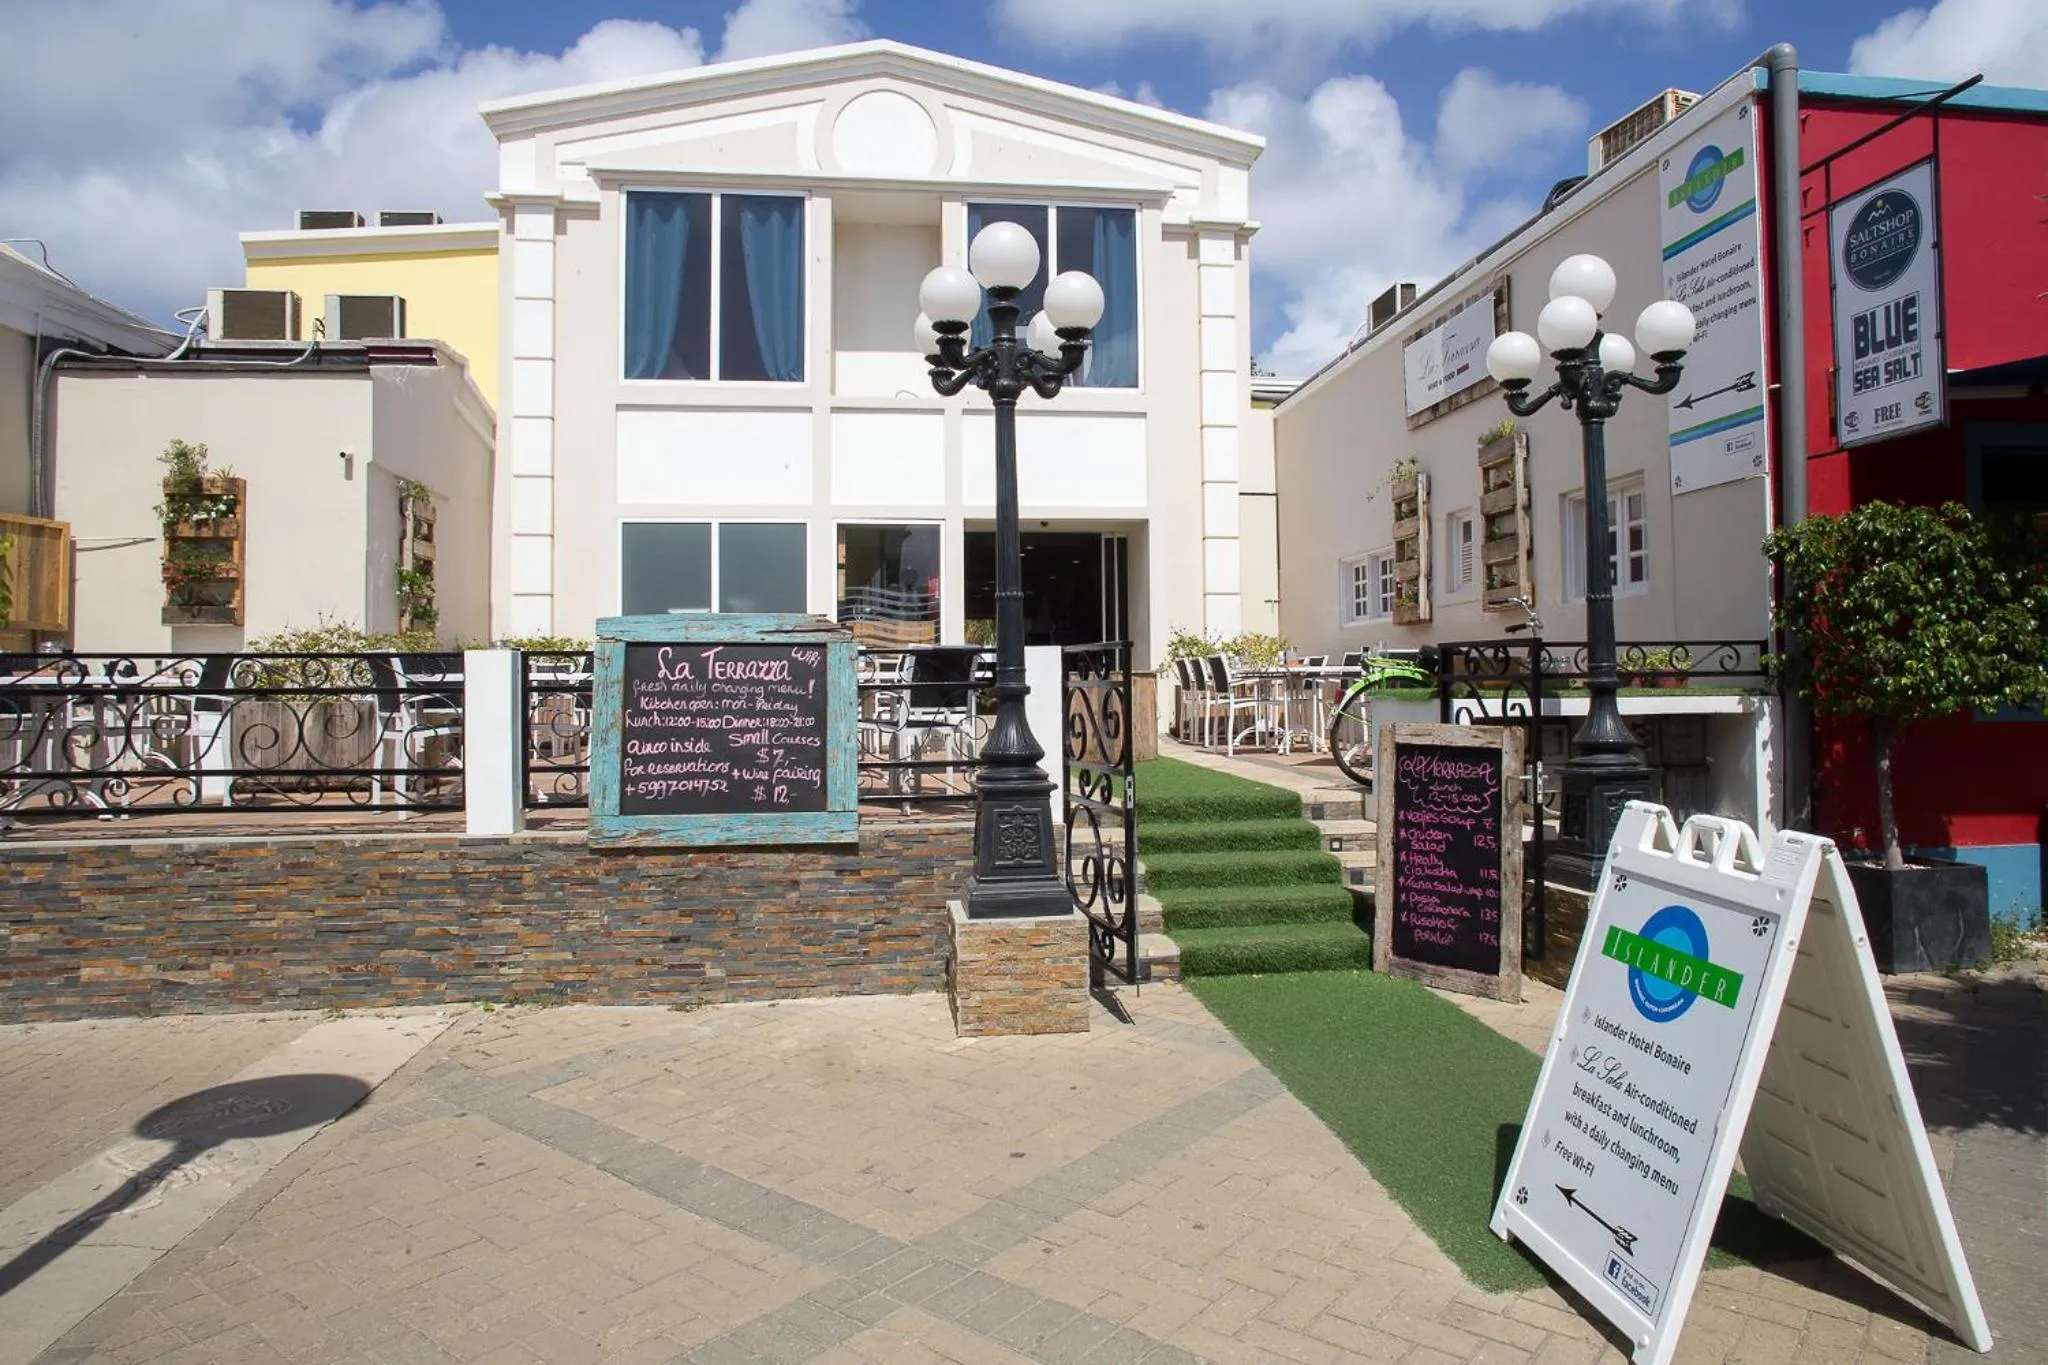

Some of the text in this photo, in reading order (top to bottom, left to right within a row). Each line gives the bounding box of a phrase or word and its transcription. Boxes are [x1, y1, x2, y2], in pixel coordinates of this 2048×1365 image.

[1850, 209, 1914, 248] SALTSHOP
[1851, 229, 1915, 262] BONAIRE
[1676, 265, 1699, 281] Islander
[1717, 243, 1742, 261] Bonaire
[1704, 294, 1716, 307] and
[1711, 304, 1738, 323] changing
[1739, 296, 1756, 310] menu
[1853, 294, 1918, 360] BLUE
[1854, 365, 1880, 393] SEA
[1884, 351, 1921, 384] SALT
[1874, 402, 1902, 424] FREE
[658, 646, 695, 680] La
[671, 681, 707, 698] daily
[1611, 930, 1727, 1000] ISLANDER
[1594, 1014, 1692, 1075] Islander Hotel Bonaire
[1577, 1046, 1698, 1135] La Sala Air-conditioned
[1573, 1081, 1680, 1163] breakfast and lunchroom,
[1554, 1140, 1573, 1161] Free
[1564, 1110, 1680, 1196] with a daily changing menu
